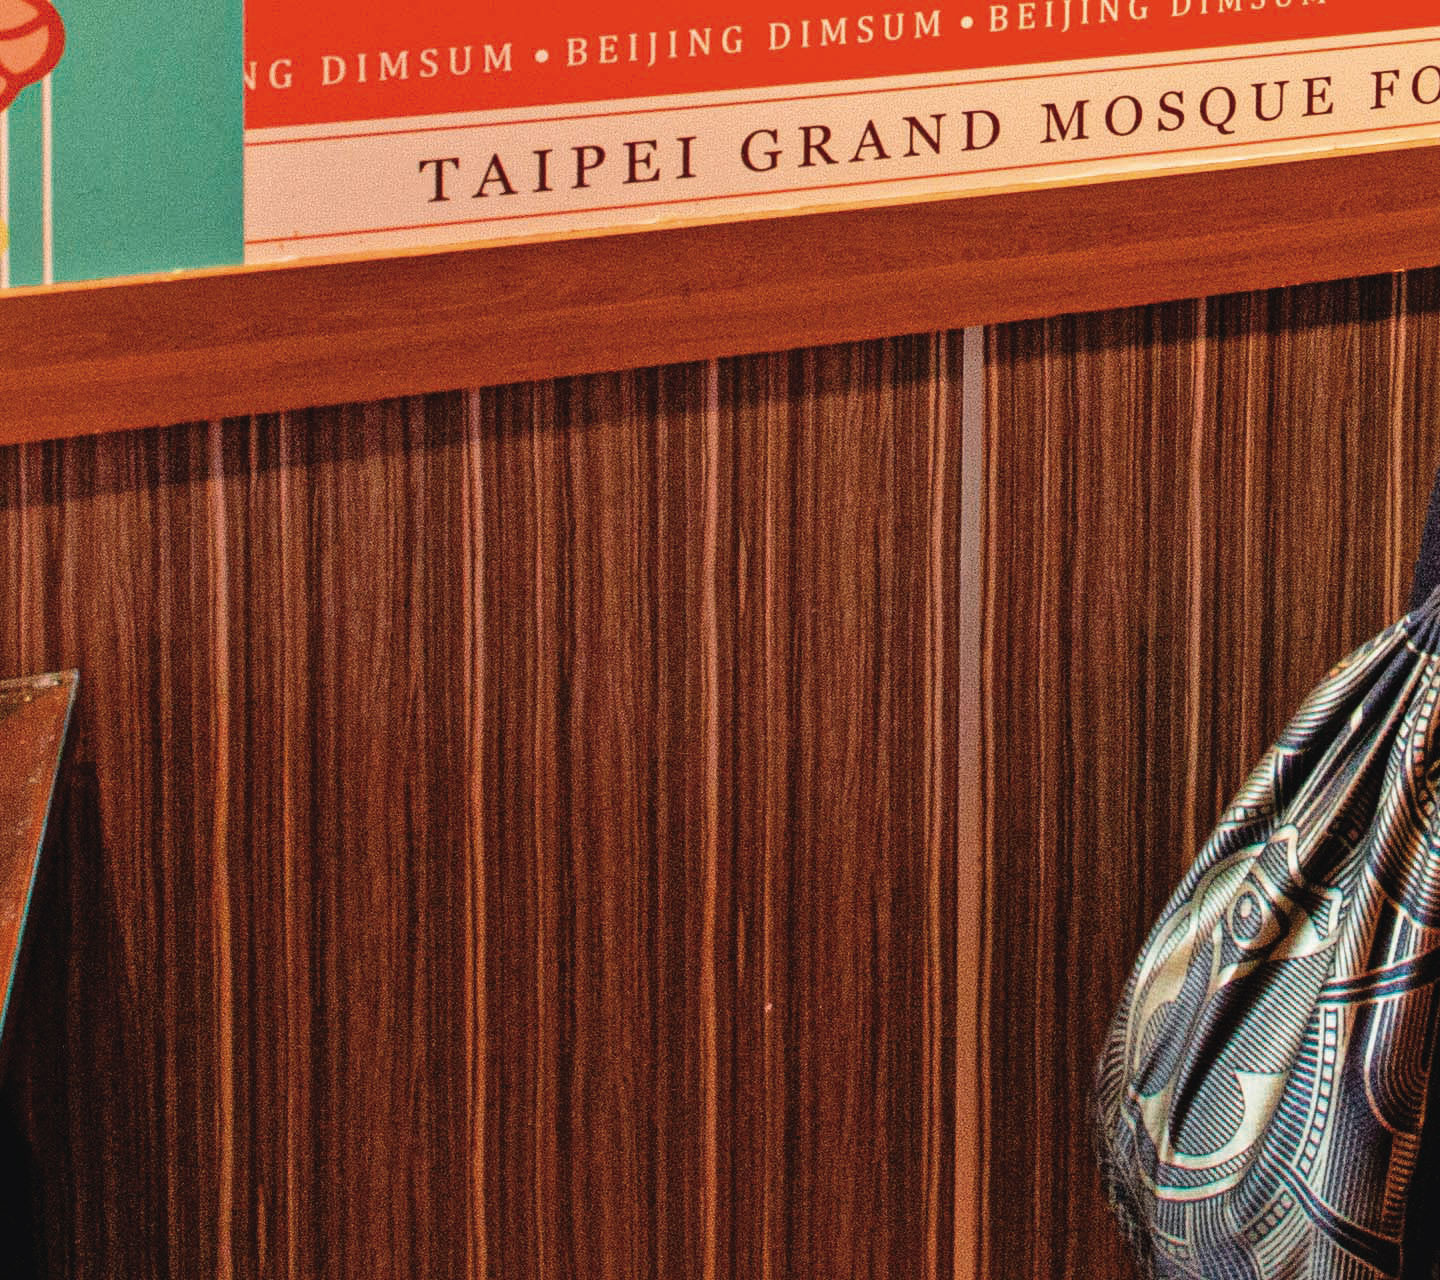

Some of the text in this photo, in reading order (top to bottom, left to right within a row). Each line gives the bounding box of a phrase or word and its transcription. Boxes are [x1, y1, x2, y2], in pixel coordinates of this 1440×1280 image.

[321, 43, 515, 86] DIMSUM
[565, 26, 745, 69] BEIJING
[767, 10, 944, 52] DIMSUM
[418, 135, 697, 202] TAIPEI
[739, 108, 1002, 173] GRAND
[1040, 76, 1335, 145] MOSQUE
